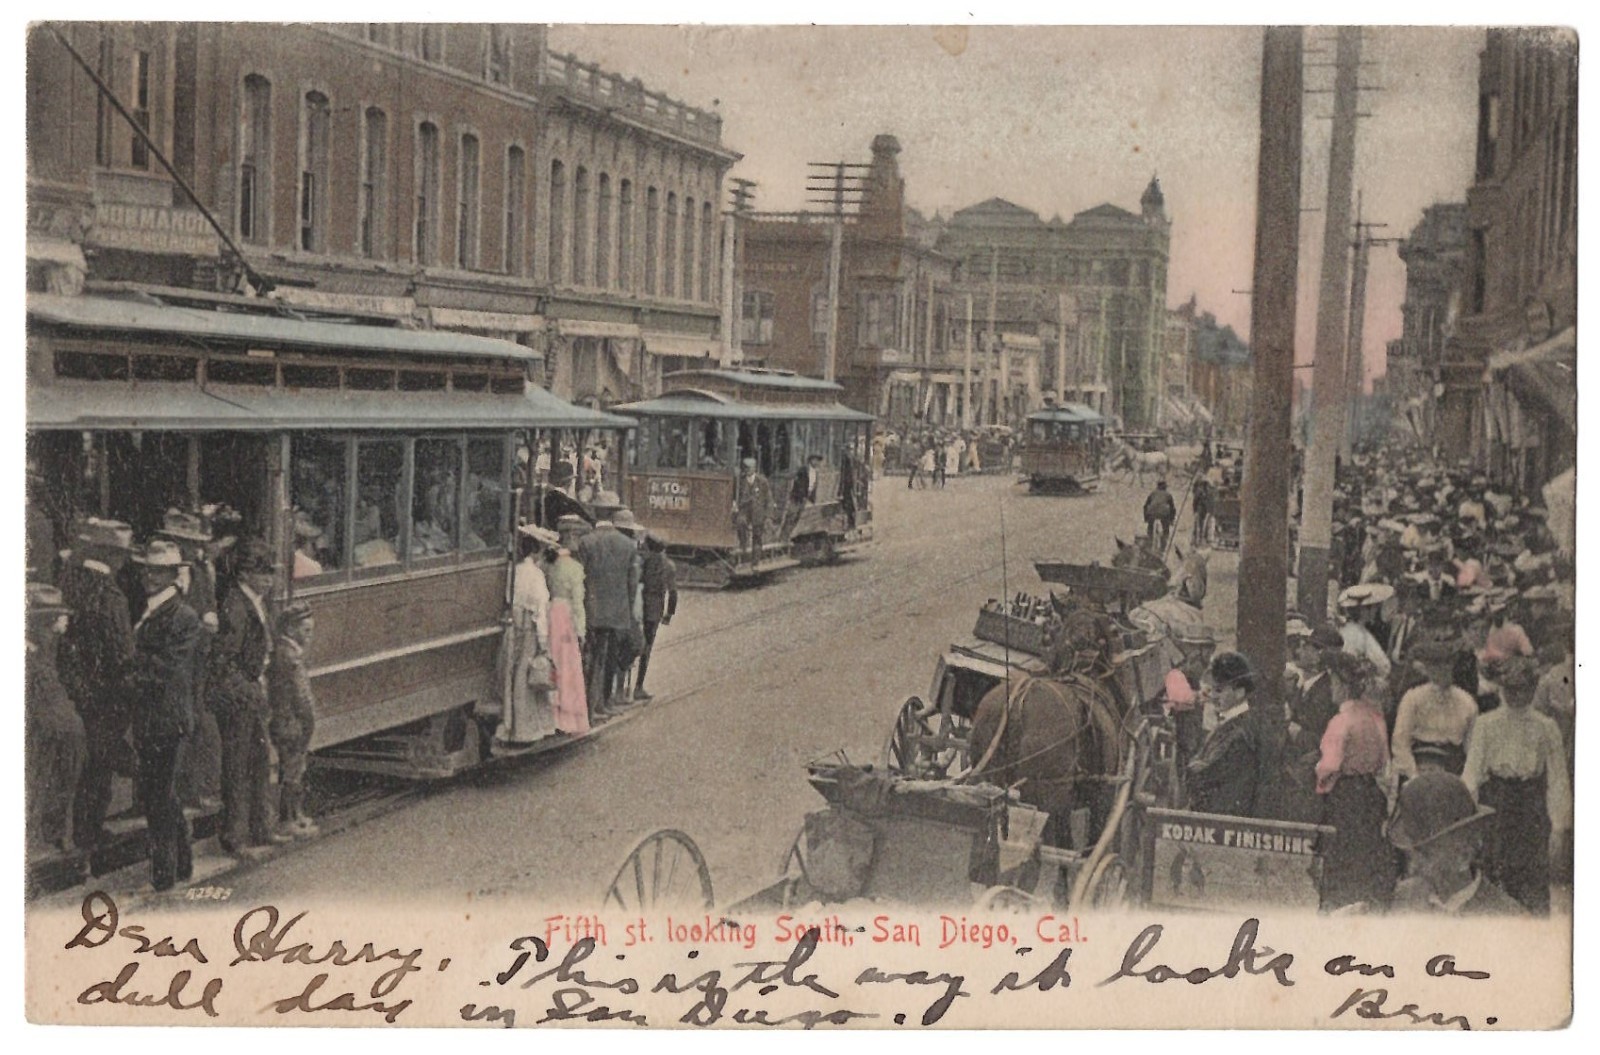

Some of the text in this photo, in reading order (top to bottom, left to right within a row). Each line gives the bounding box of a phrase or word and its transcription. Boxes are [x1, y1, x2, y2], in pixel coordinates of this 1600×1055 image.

[1161, 823, 1217, 844] KODAK
[65, 890, 208, 963] Dear
[495, 936, 639, 995] This
[731, 927, 840, 998] the
[855, 965, 971, 1026] way
[990, 947, 1073, 995] it
[1093, 917, 1295, 987] looks
[1324, 955, 1395, 979] on
[1425, 954, 1491, 980] a
[77, 962, 223, 1018] dull
[256, 973, 413, 1024] day
[460, 1003, 516, 1029] in
[535, 978, 648, 1027] San
